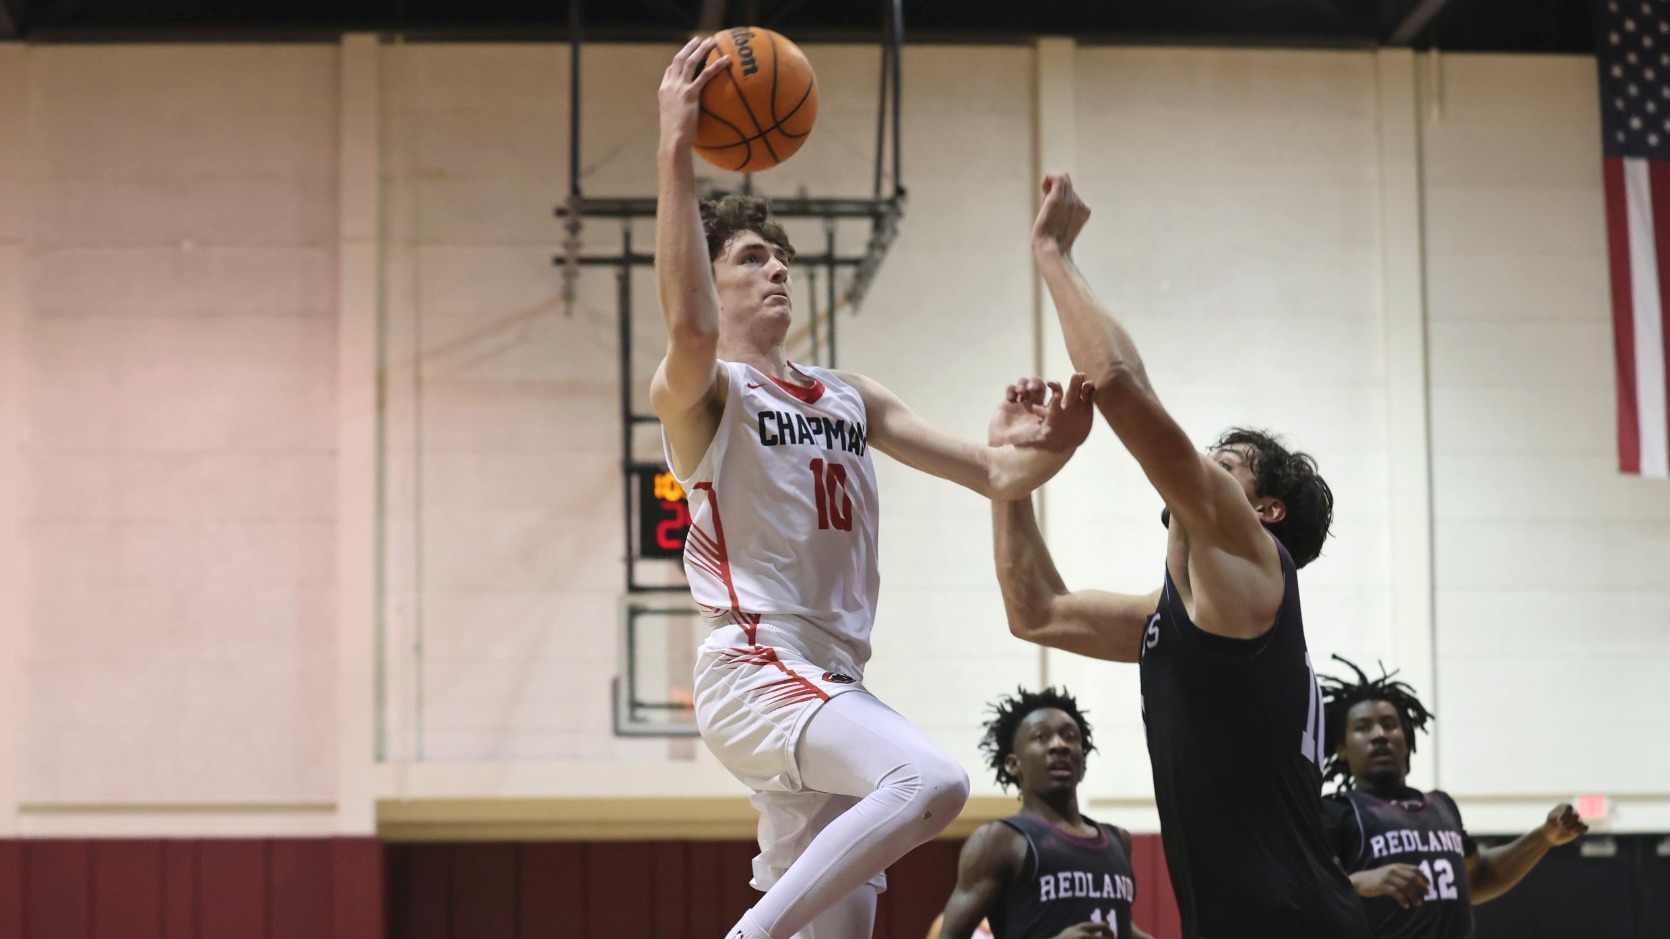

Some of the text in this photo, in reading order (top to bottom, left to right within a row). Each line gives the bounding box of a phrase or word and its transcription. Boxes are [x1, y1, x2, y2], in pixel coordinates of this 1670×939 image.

[757, 410, 867, 457] CHAPMAN
[809, 457, 853, 531] 10
[1419, 858, 1458, 901] 12
